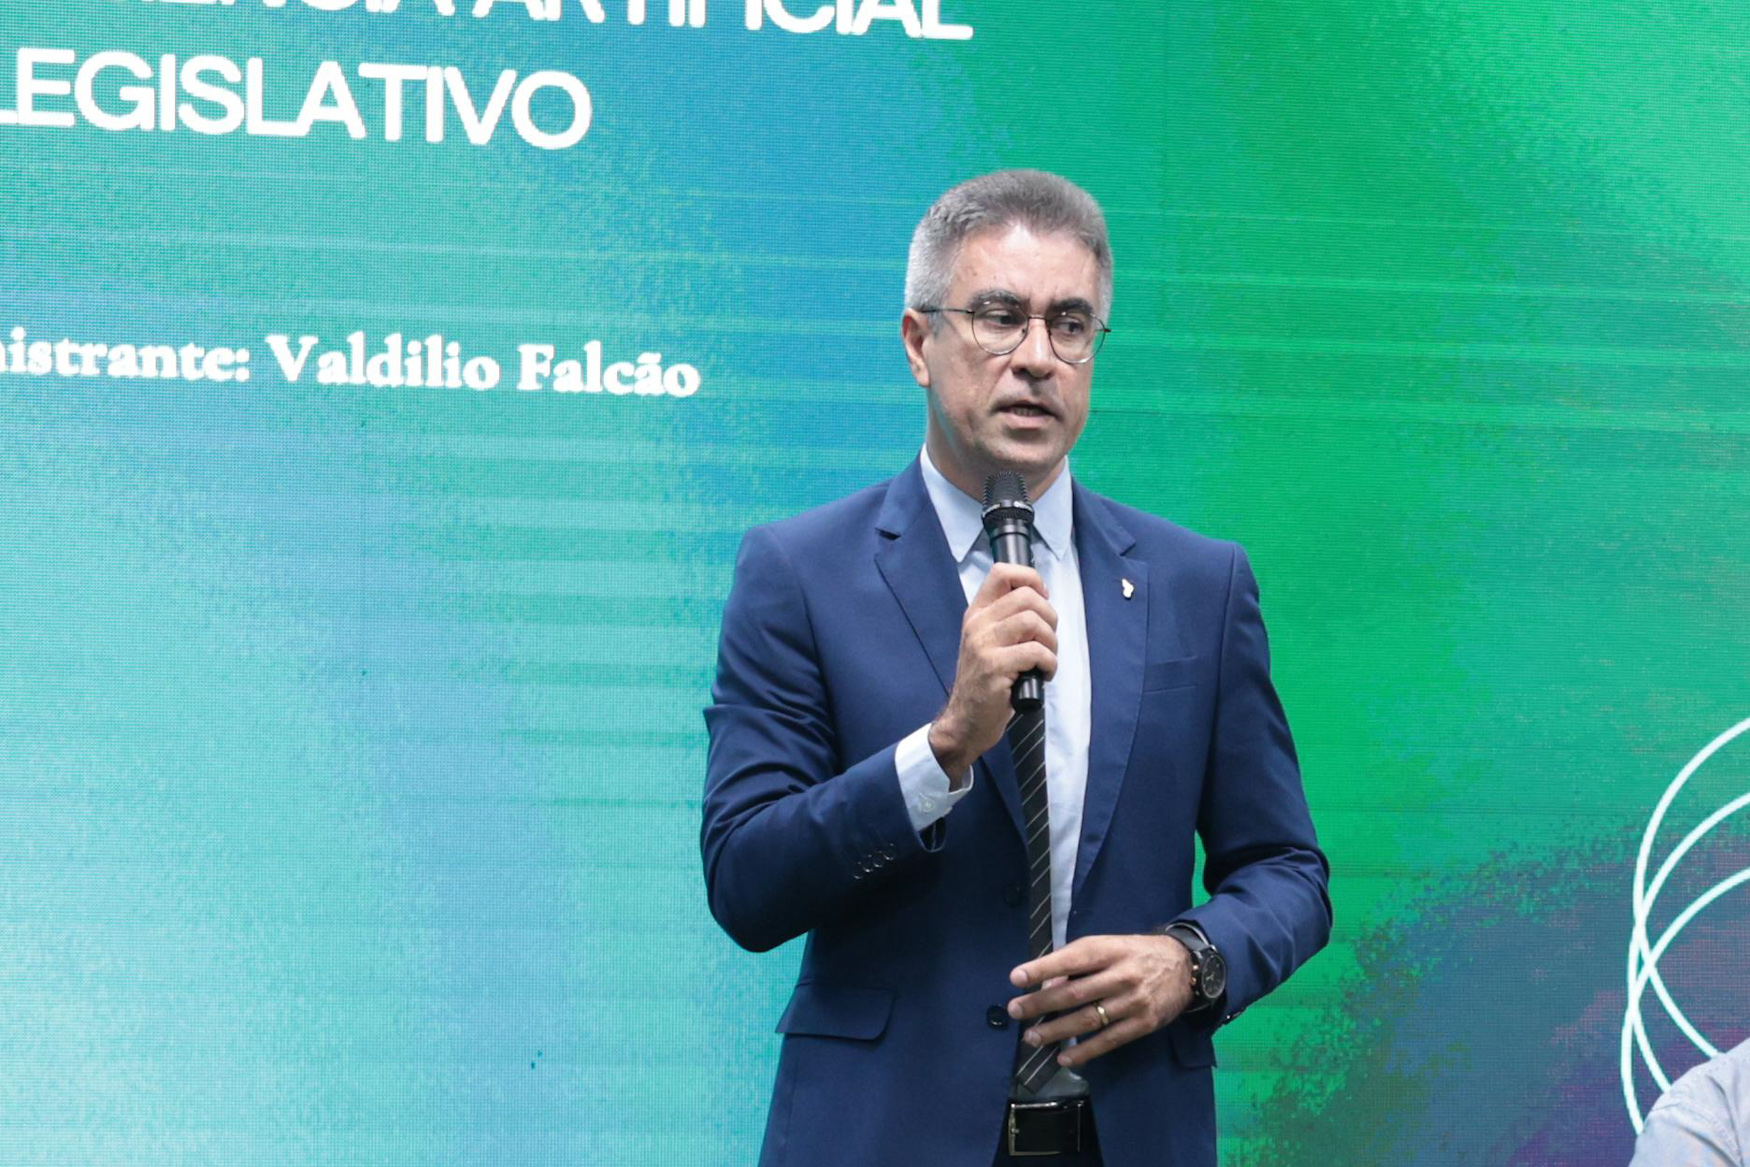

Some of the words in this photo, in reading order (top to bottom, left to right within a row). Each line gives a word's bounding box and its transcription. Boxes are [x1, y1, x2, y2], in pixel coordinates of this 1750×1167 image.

[0, 326, 250, 382] istrante:
[265, 331, 500, 390] Valdilio
[517, 340, 700, 397] Falcão
